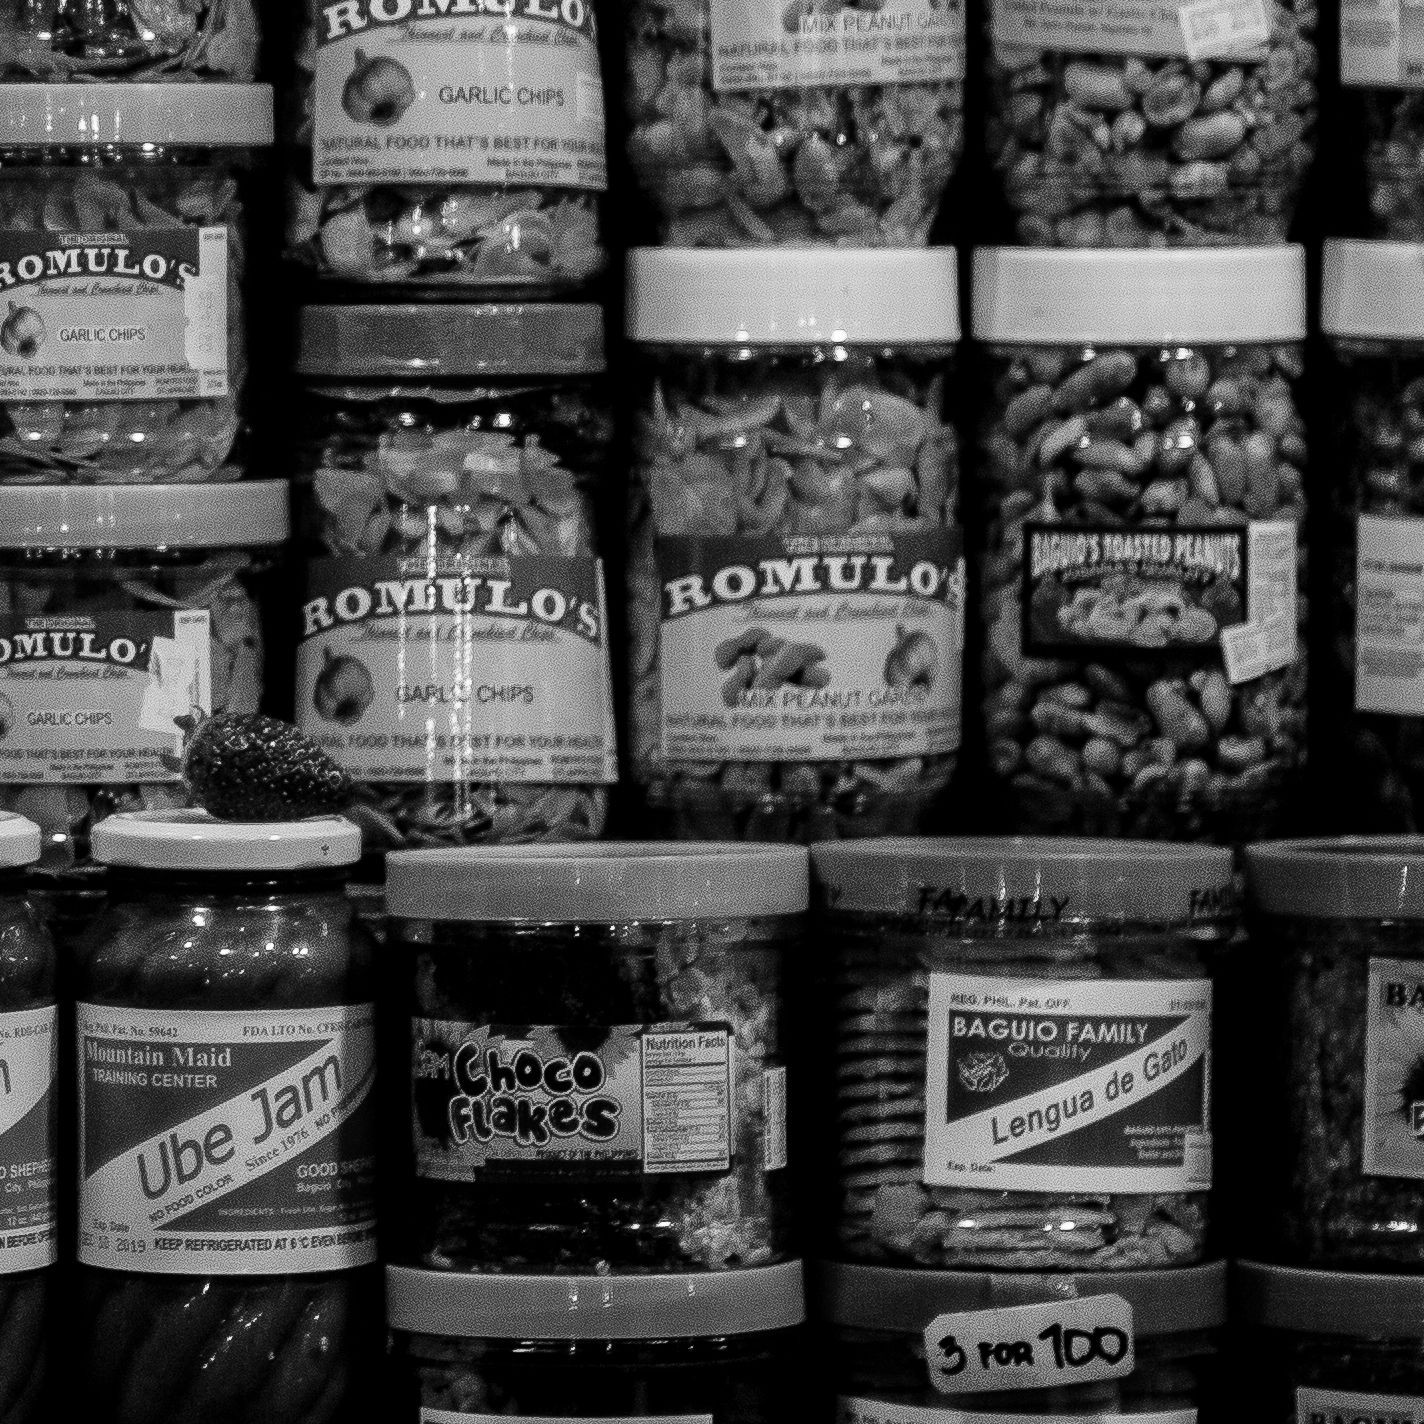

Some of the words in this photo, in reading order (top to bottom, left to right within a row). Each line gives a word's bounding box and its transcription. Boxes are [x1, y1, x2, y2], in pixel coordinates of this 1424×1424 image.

[59, 328, 106, 342] GARLIC
[109, 327, 146, 342] CHIPS
[303, 578, 598, 637] ROMULO'S
[27, 712, 72, 726] GARLIC
[75, 712, 112, 726] CHIPS
[152, 1072, 218, 1089] CENTER
[454, 1041, 605, 1098] Choco
[991, 1088, 1095, 1146] Lengua
[1105, 1070, 1134, 1102] de
[1143, 1038, 1188, 1084] Gato
[136, 1123, 236, 1201] Ube
[252, 1054, 342, 1145] Jam
[450, 1093, 622, 1146] Flakes
[937, 1331, 968, 1376] 3
[978, 1338, 1035, 1369] FOR
[1037, 1320, 1131, 1370] 100
